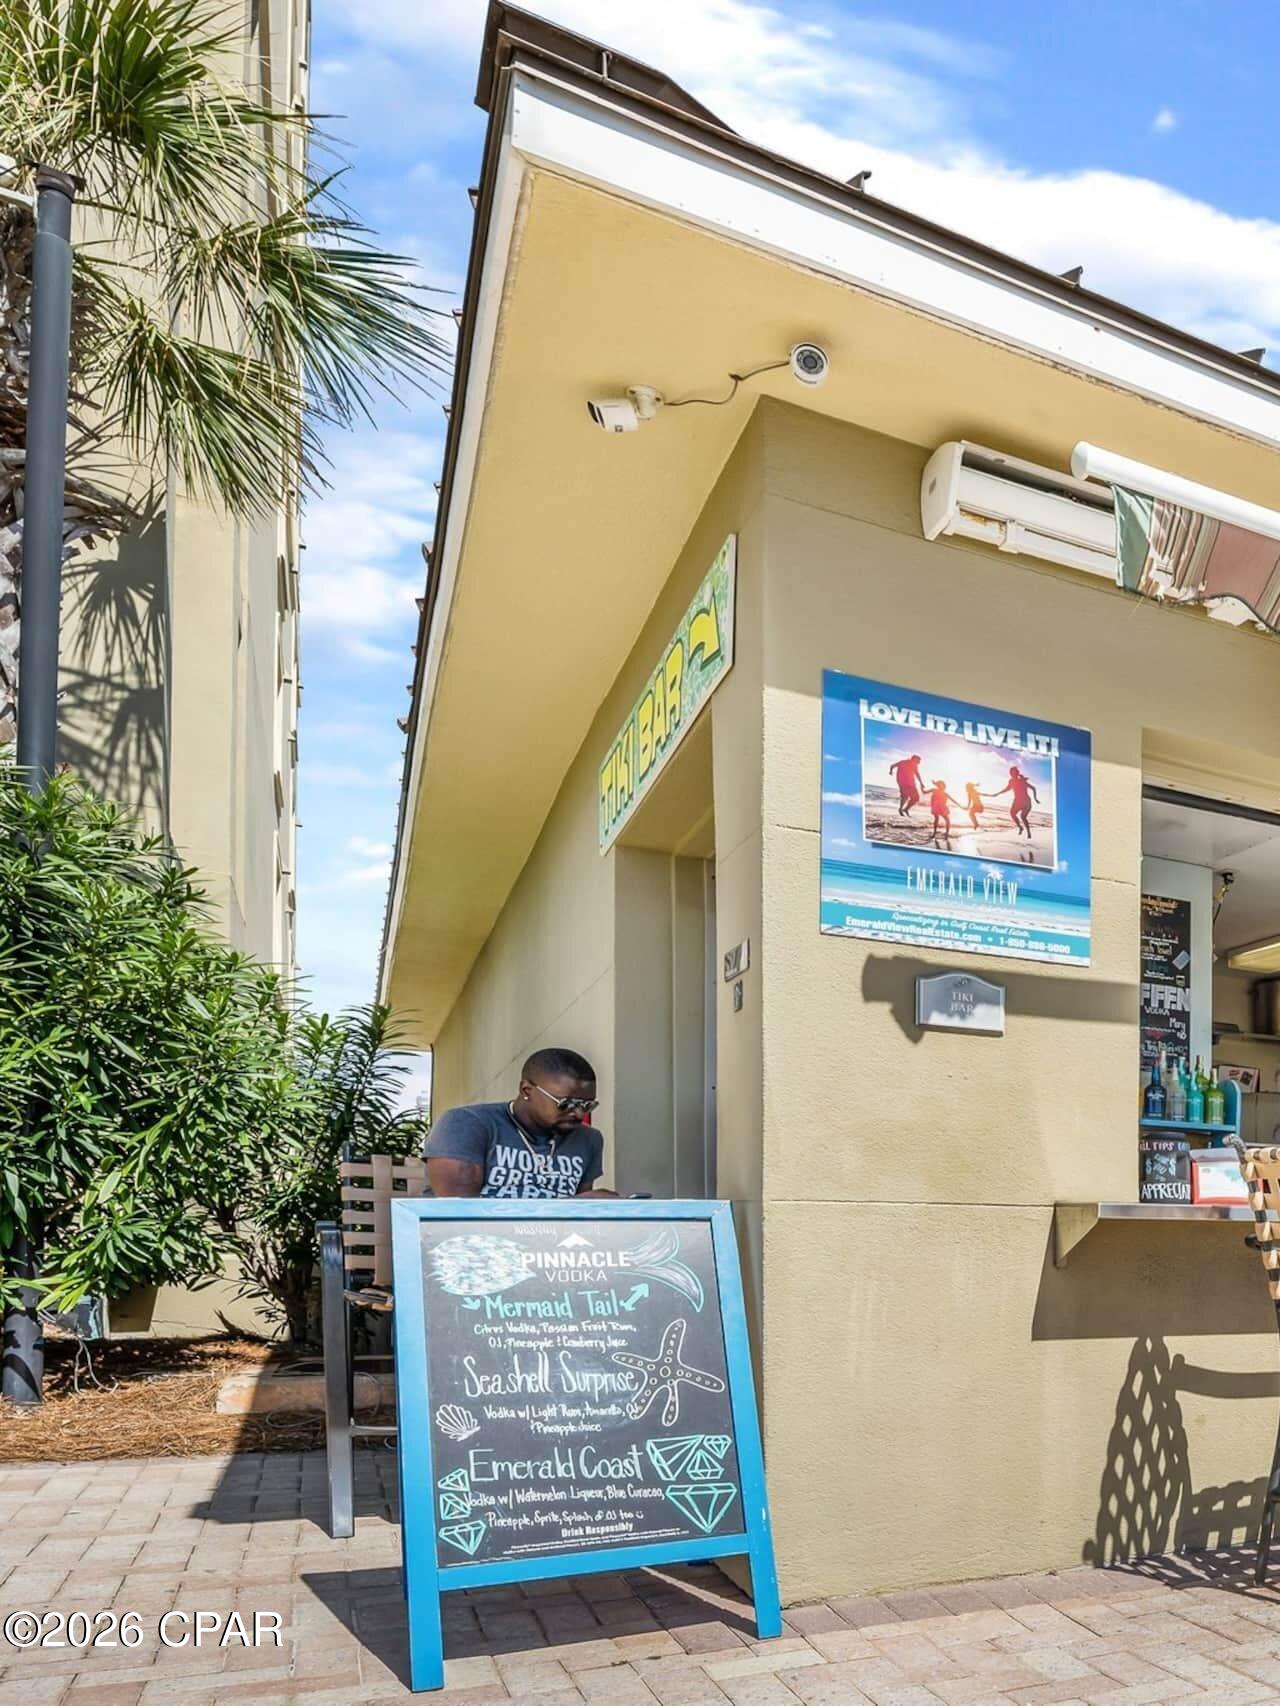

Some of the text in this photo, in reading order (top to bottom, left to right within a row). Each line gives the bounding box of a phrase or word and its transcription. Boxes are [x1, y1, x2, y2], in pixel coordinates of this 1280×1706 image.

[600, 637, 686, 837] TIKI BAR
[859, 698, 1060, 758] LOVE IT? LIVE IT!
[906, 866, 974, 898] EMERALD
[983, 877, 1019, 905] VIEW
[950, 1002, 974, 1015] BAR
[951, 991, 974, 1003] TIKI
[1140, 983, 1191, 1012] FFEN
[495, 1144, 584, 1178] WORLDS
[521, 1250, 633, 1270] PINNACLE
[544, 1269, 608, 1283] VODKA
[484, 1288, 619, 1319] Mermaid Tail
[559, 1350, 639, 1402] Surprise
[483, 1404, 516, 1419] Vodka
[531, 1403, 558, 1421] Light
[469, 1444, 644, 1482] Emerald Coast
[463, 1492, 495, 1507] Vodka
[514, 1485, 567, 1503] Watermelon
[606, 1484, 627, 1499] Blue
[561, 1521, 633, 1537] Drink Responsibly
[562, 1510, 594, 1526] Splash
